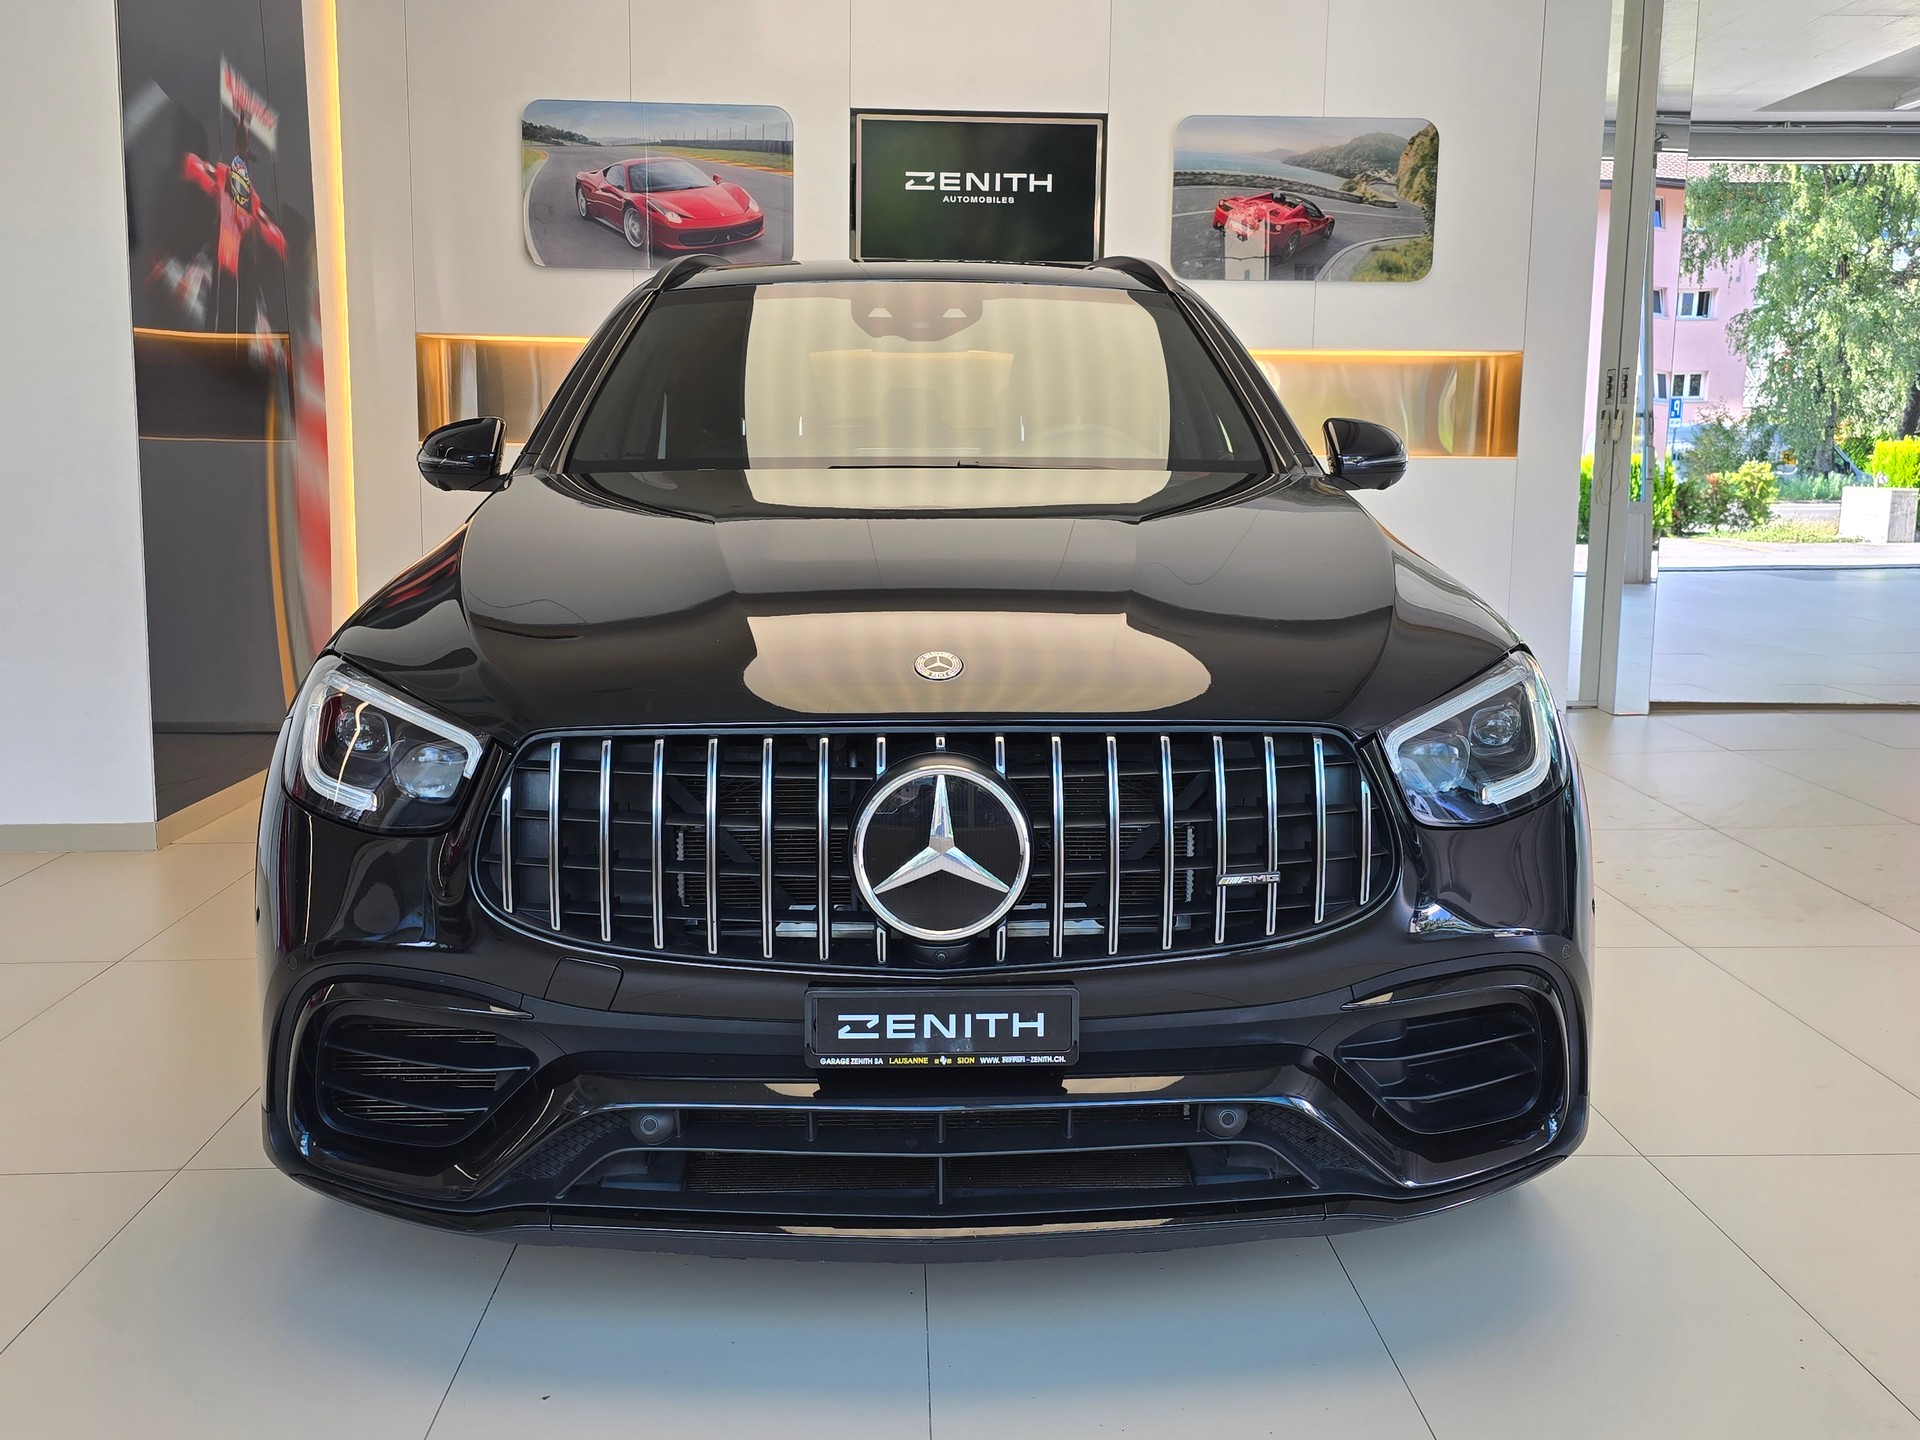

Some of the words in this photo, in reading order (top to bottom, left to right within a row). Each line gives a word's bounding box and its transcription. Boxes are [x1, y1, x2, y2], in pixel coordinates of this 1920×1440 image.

[905, 171, 1053, 193] ZENITH
[942, 195, 1015, 204] AUTOMOBILES
[838, 1012, 1045, 1039] ZENITH
[820, 1057, 850, 1065] GARAGE
[850, 1057, 873, 1065] ZENITH
[874, 1057, 884, 1065] SA
[889, 1057, 928, 1065] LAUSANNE
